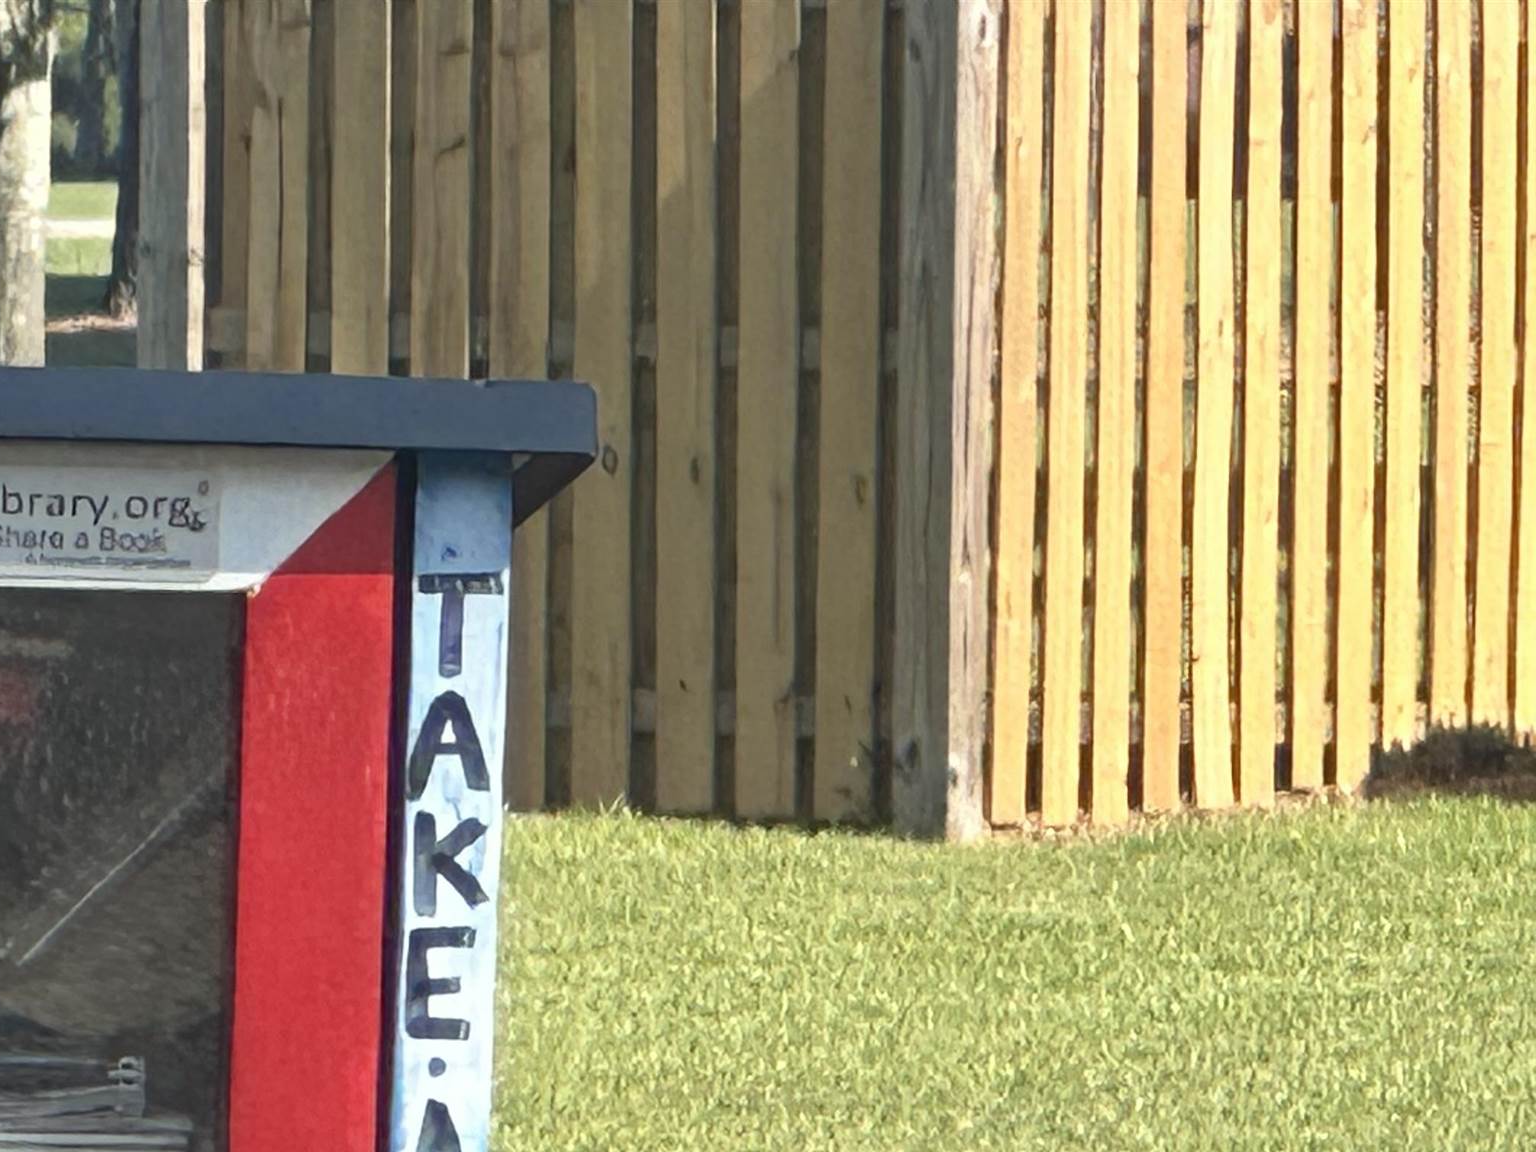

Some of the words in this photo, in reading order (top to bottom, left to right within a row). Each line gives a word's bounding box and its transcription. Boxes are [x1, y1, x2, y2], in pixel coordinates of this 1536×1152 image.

[74, 532, 89, 550] a
[99, 526, 167, 553] Book
[406, 571, 505, 1042] TAKE
